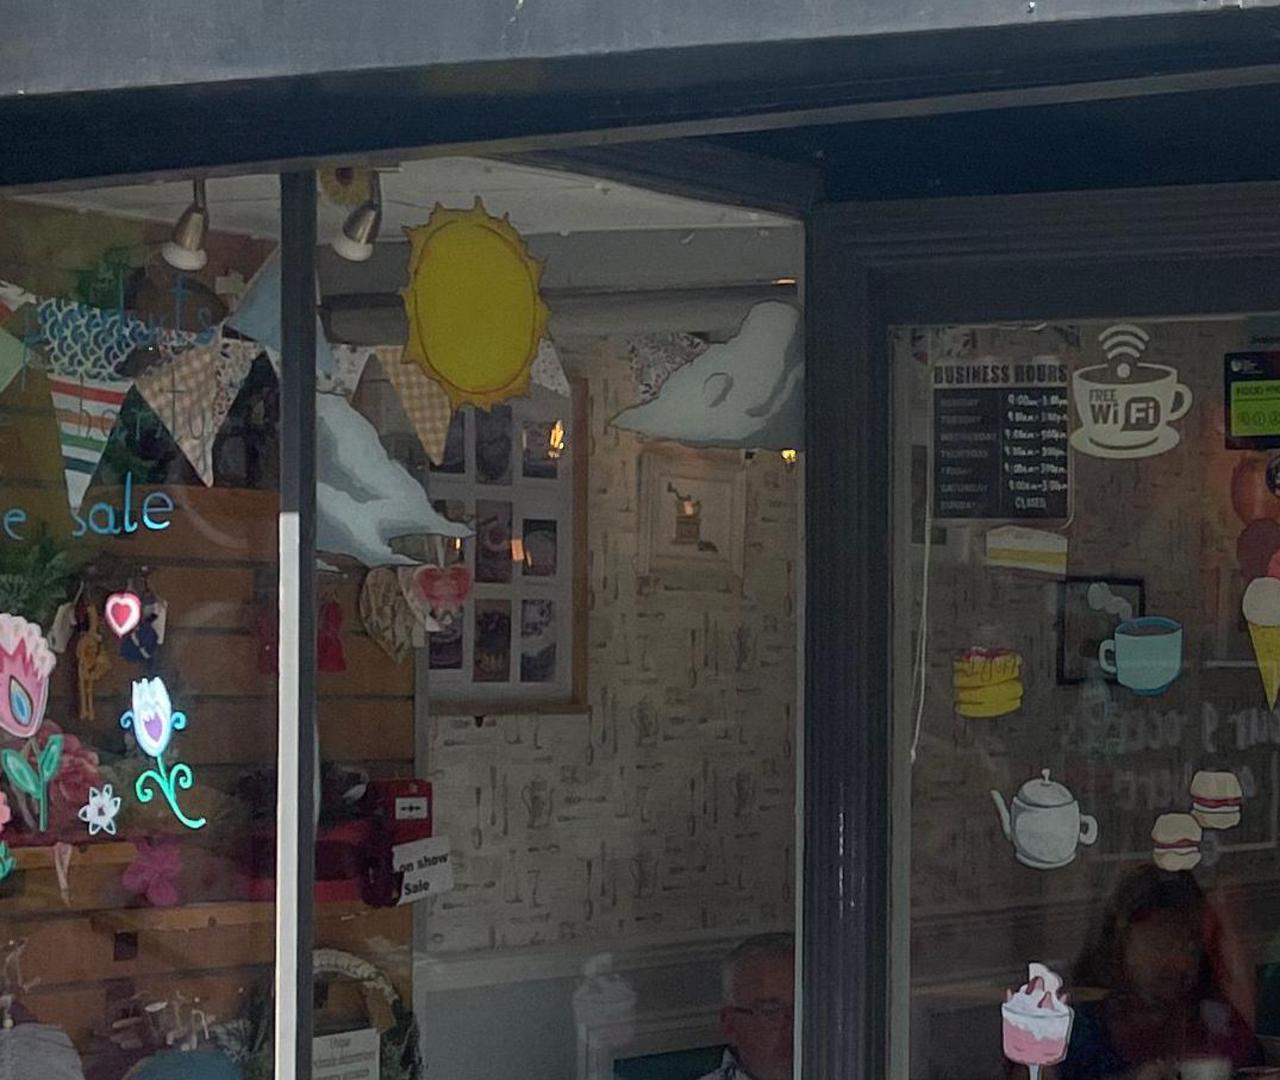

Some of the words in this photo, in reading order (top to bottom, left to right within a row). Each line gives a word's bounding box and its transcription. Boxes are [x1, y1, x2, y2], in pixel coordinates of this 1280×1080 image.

[933, 366, 1010, 384] BUSINESS
[1013, 365, 1068, 383] HOURS
[416, 853, 449, 870] show
[404, 879, 431, 896] Sale
